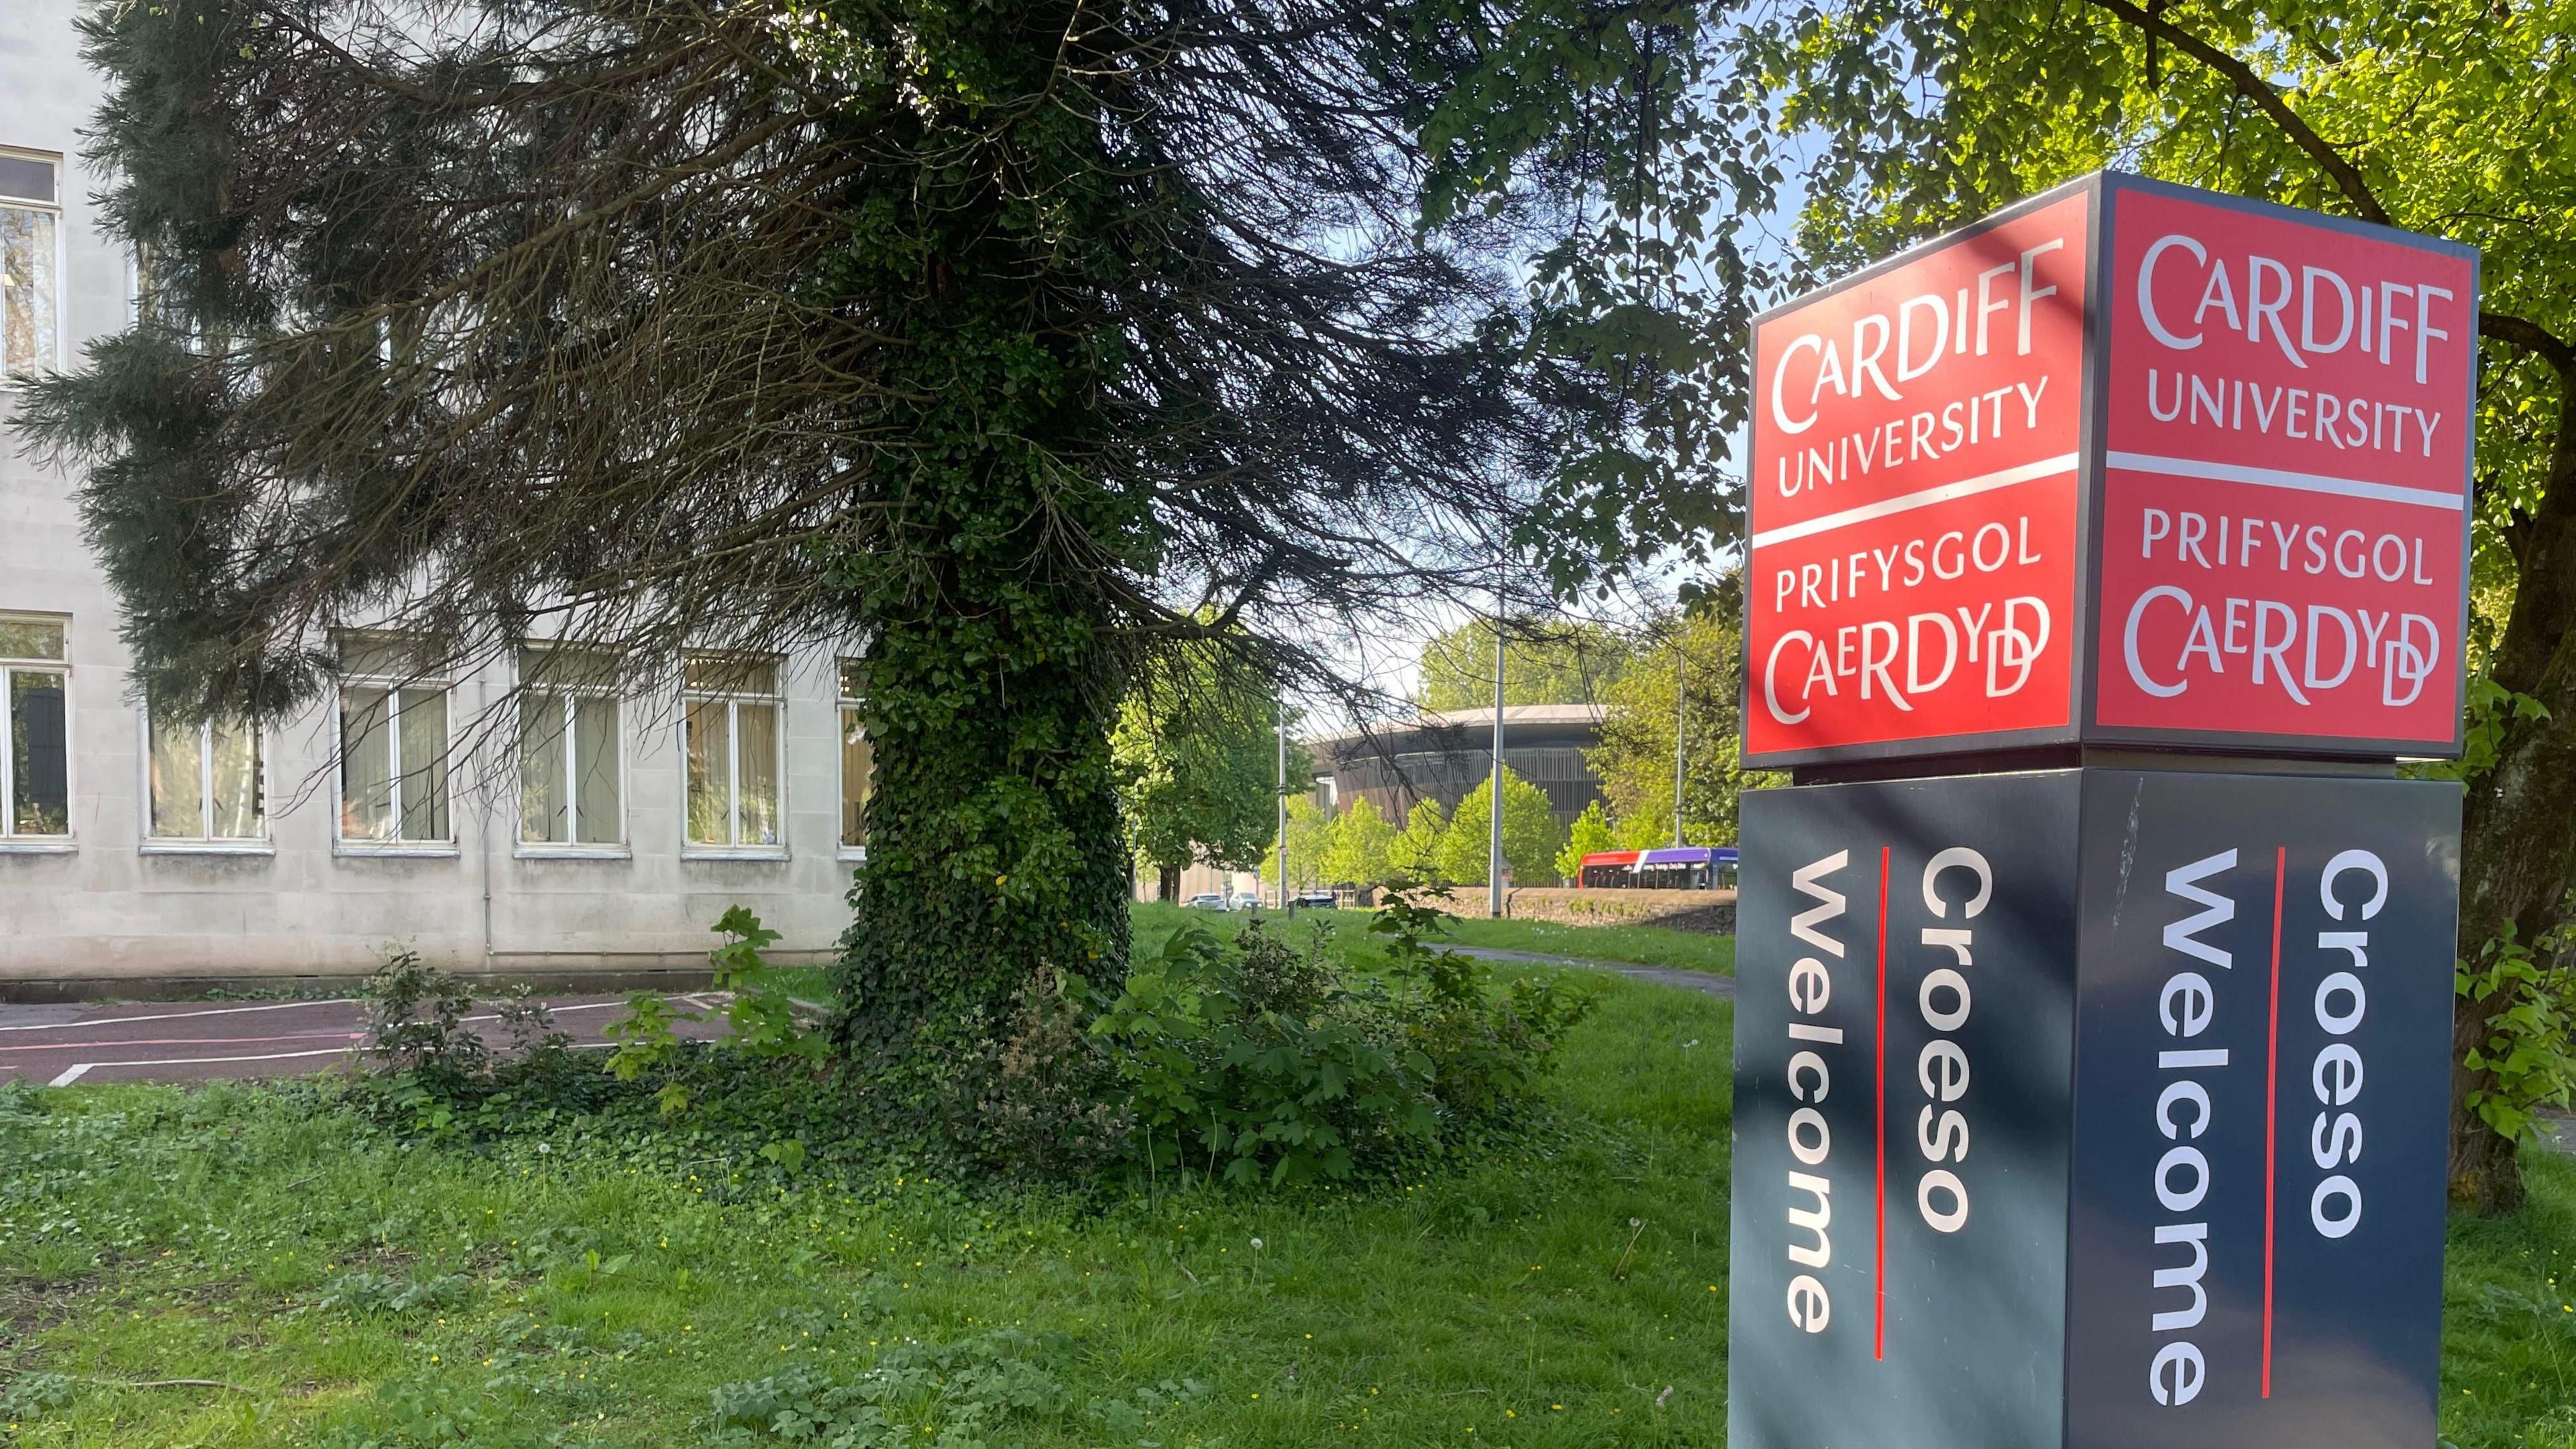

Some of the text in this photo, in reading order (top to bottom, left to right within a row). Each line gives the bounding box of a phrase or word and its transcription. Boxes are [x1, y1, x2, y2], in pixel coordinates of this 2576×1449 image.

[1772, 237, 2063, 434] CARDIFF
[2138, 235, 2453, 384] CARDIFF
[1780, 376, 2049, 497] UNIVERSITY
[2148, 369, 2441, 457] UNIVERSITY
[1776, 517, 2041, 612] PRIFYSGOL
[2143, 508, 2433, 586] PRIFYSGOL
[1765, 596, 2050, 724] CAERDYDD
[2125, 586, 2439, 706] CAERDYDD
[1787, 849, 1848, 1334] Welcome
[1918, 847, 1992, 1233] Croeso
[2311, 849, 2389, 1238] Croeso
[2150, 848, 2238, 1405] Welcome
